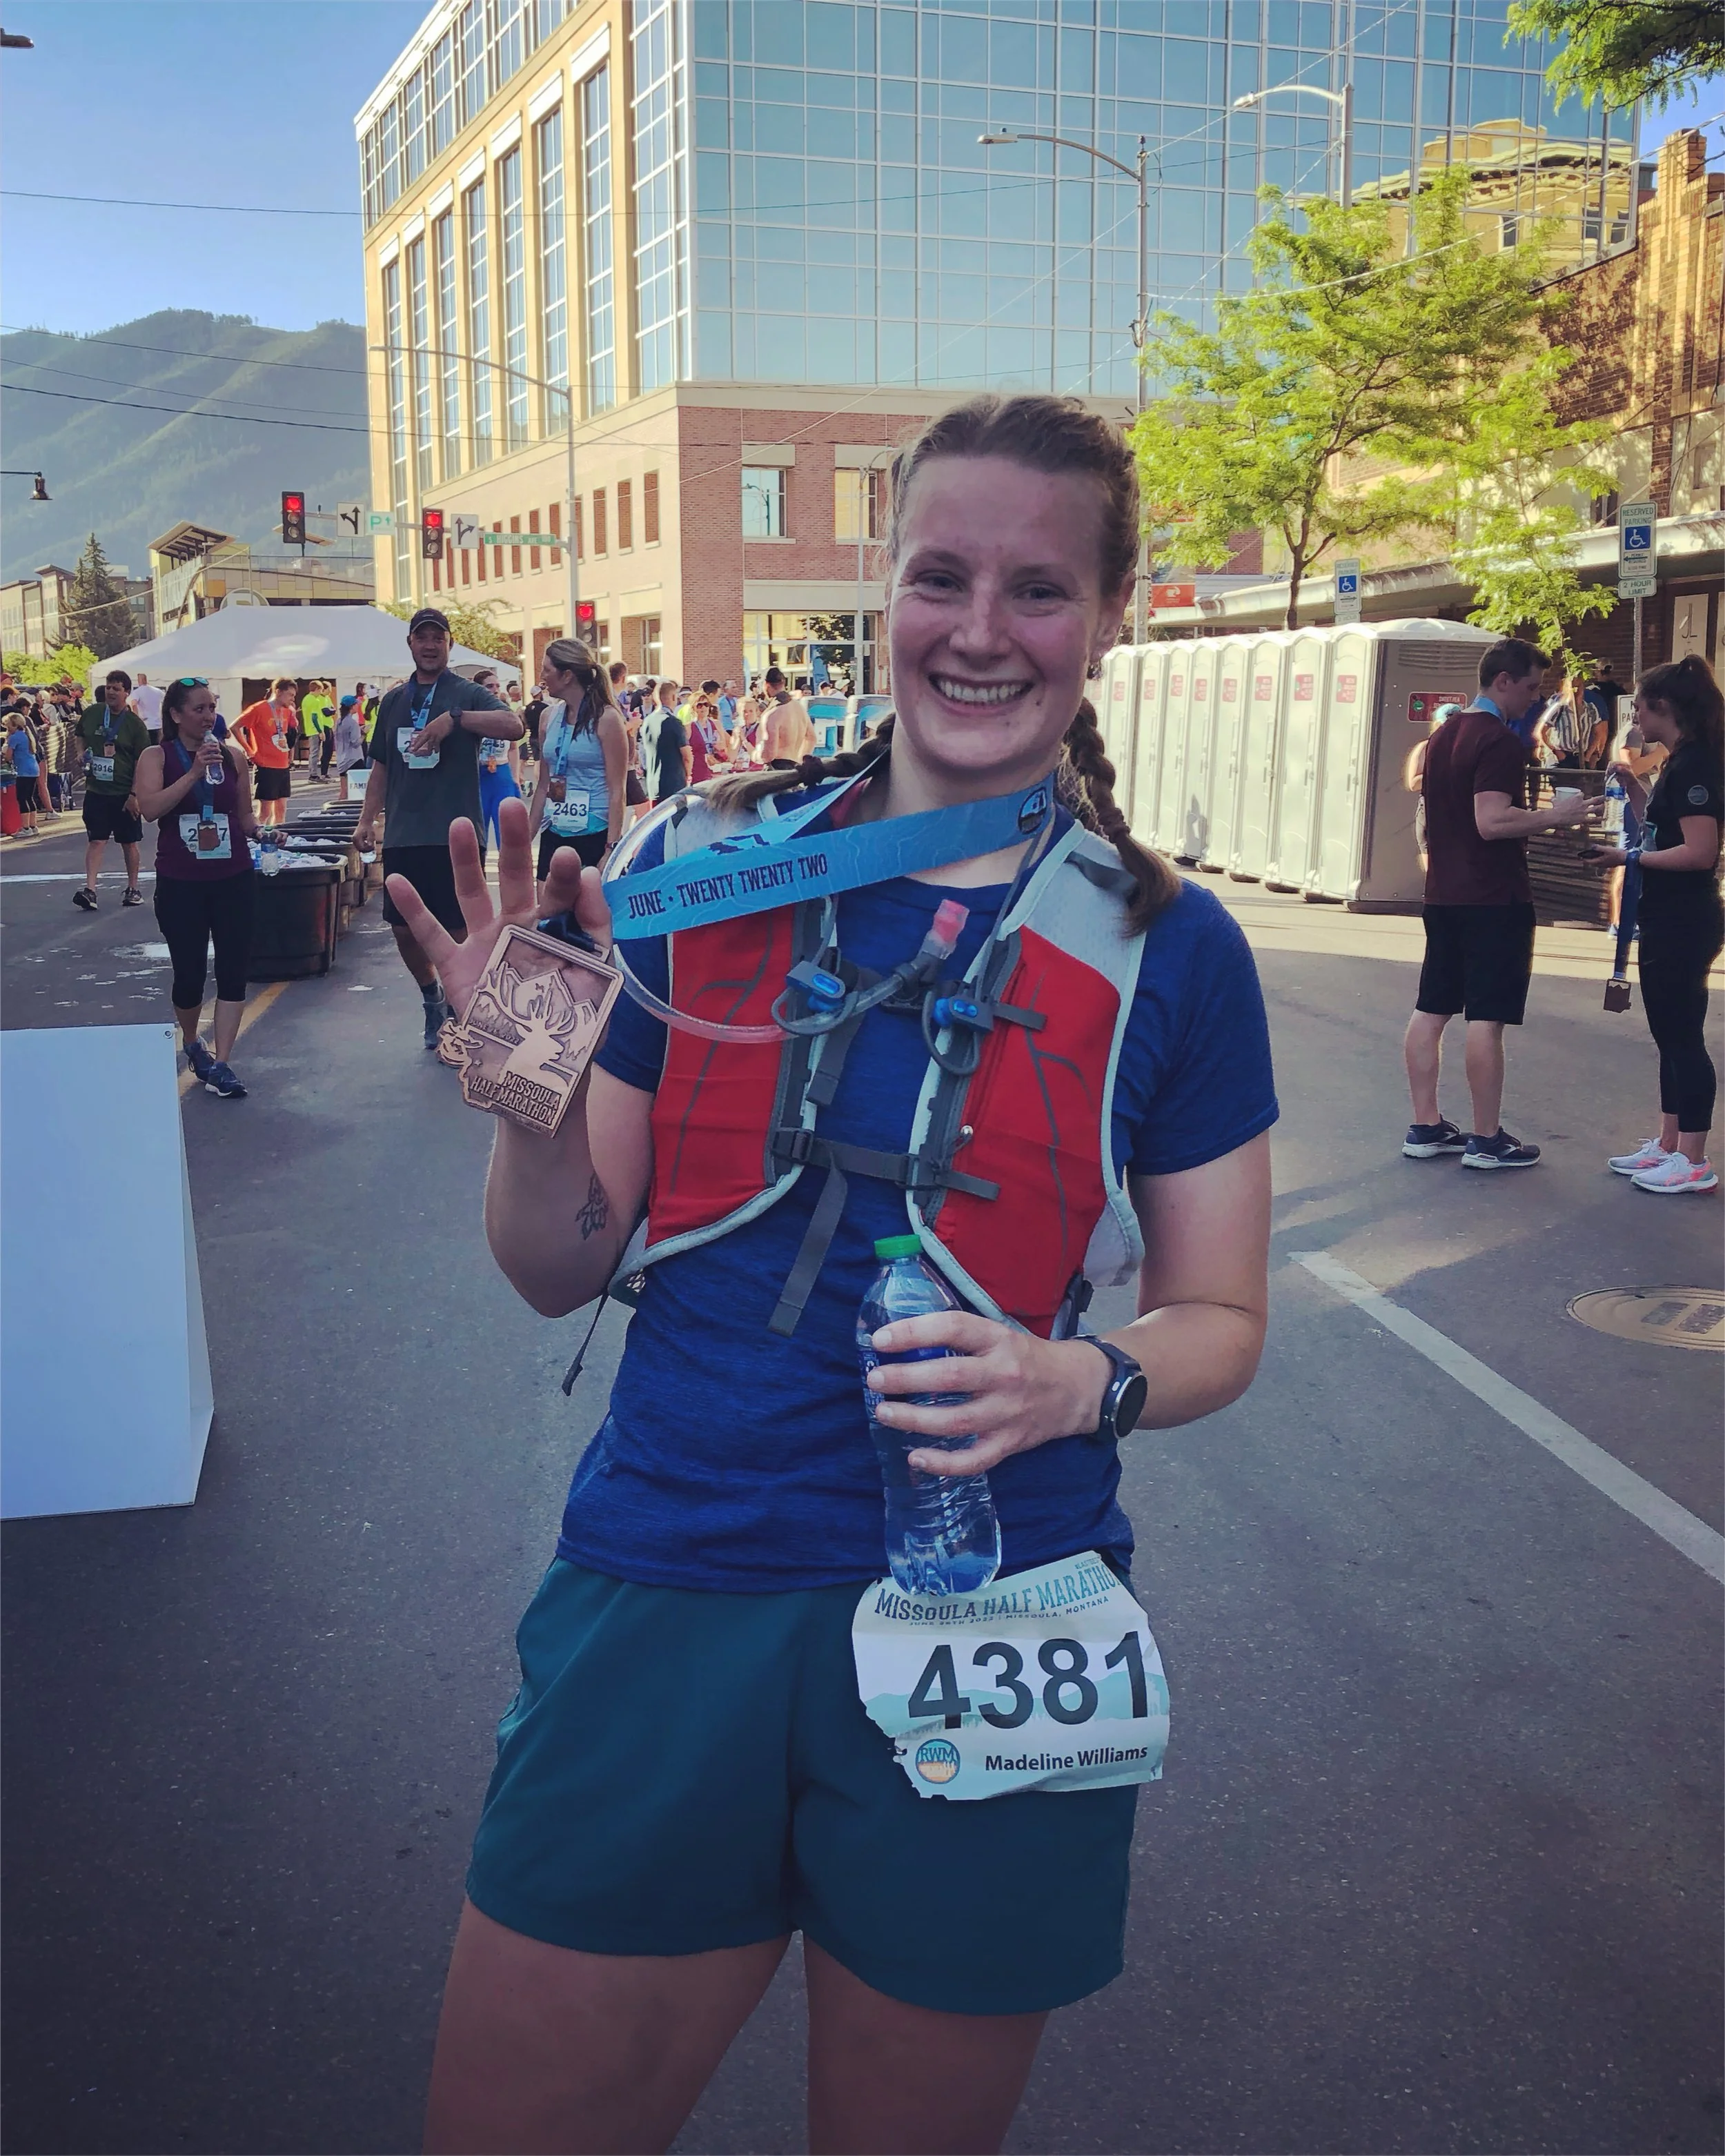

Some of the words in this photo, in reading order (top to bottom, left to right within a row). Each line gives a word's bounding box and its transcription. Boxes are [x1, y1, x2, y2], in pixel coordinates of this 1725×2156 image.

[1623, 507, 1653, 516] RESERVED
[370, 515, 381, 531] P
[1624, 517, 1652, 526] PARKING
[497, 535, 524, 544] HIGGINS
[94, 764, 112, 773] 2916
[553, 803, 587, 817] 2463
[628, 890, 666, 919] JUNE
[676, 873, 736, 907] TWENTY
[738, 860, 793, 893] TWENTY
[797, 853, 827, 879] TWO
[503, 1071, 561, 1109] MISSOULA
[470, 1076, 500, 1098] HALF
[496, 1087, 556, 1125] MARATHON
[874, 1588, 976, 1621] MISSOULA
[983, 1588, 1032, 1615] HALF
[1066, 1596, 1109, 1614] MONTANA
[908, 1631, 1148, 1729] 4381
[920, 1747, 956, 1762] RWM
[985, 1752, 1074, 1772] Madeline
[1077, 1746, 1148, 1767] Williams
